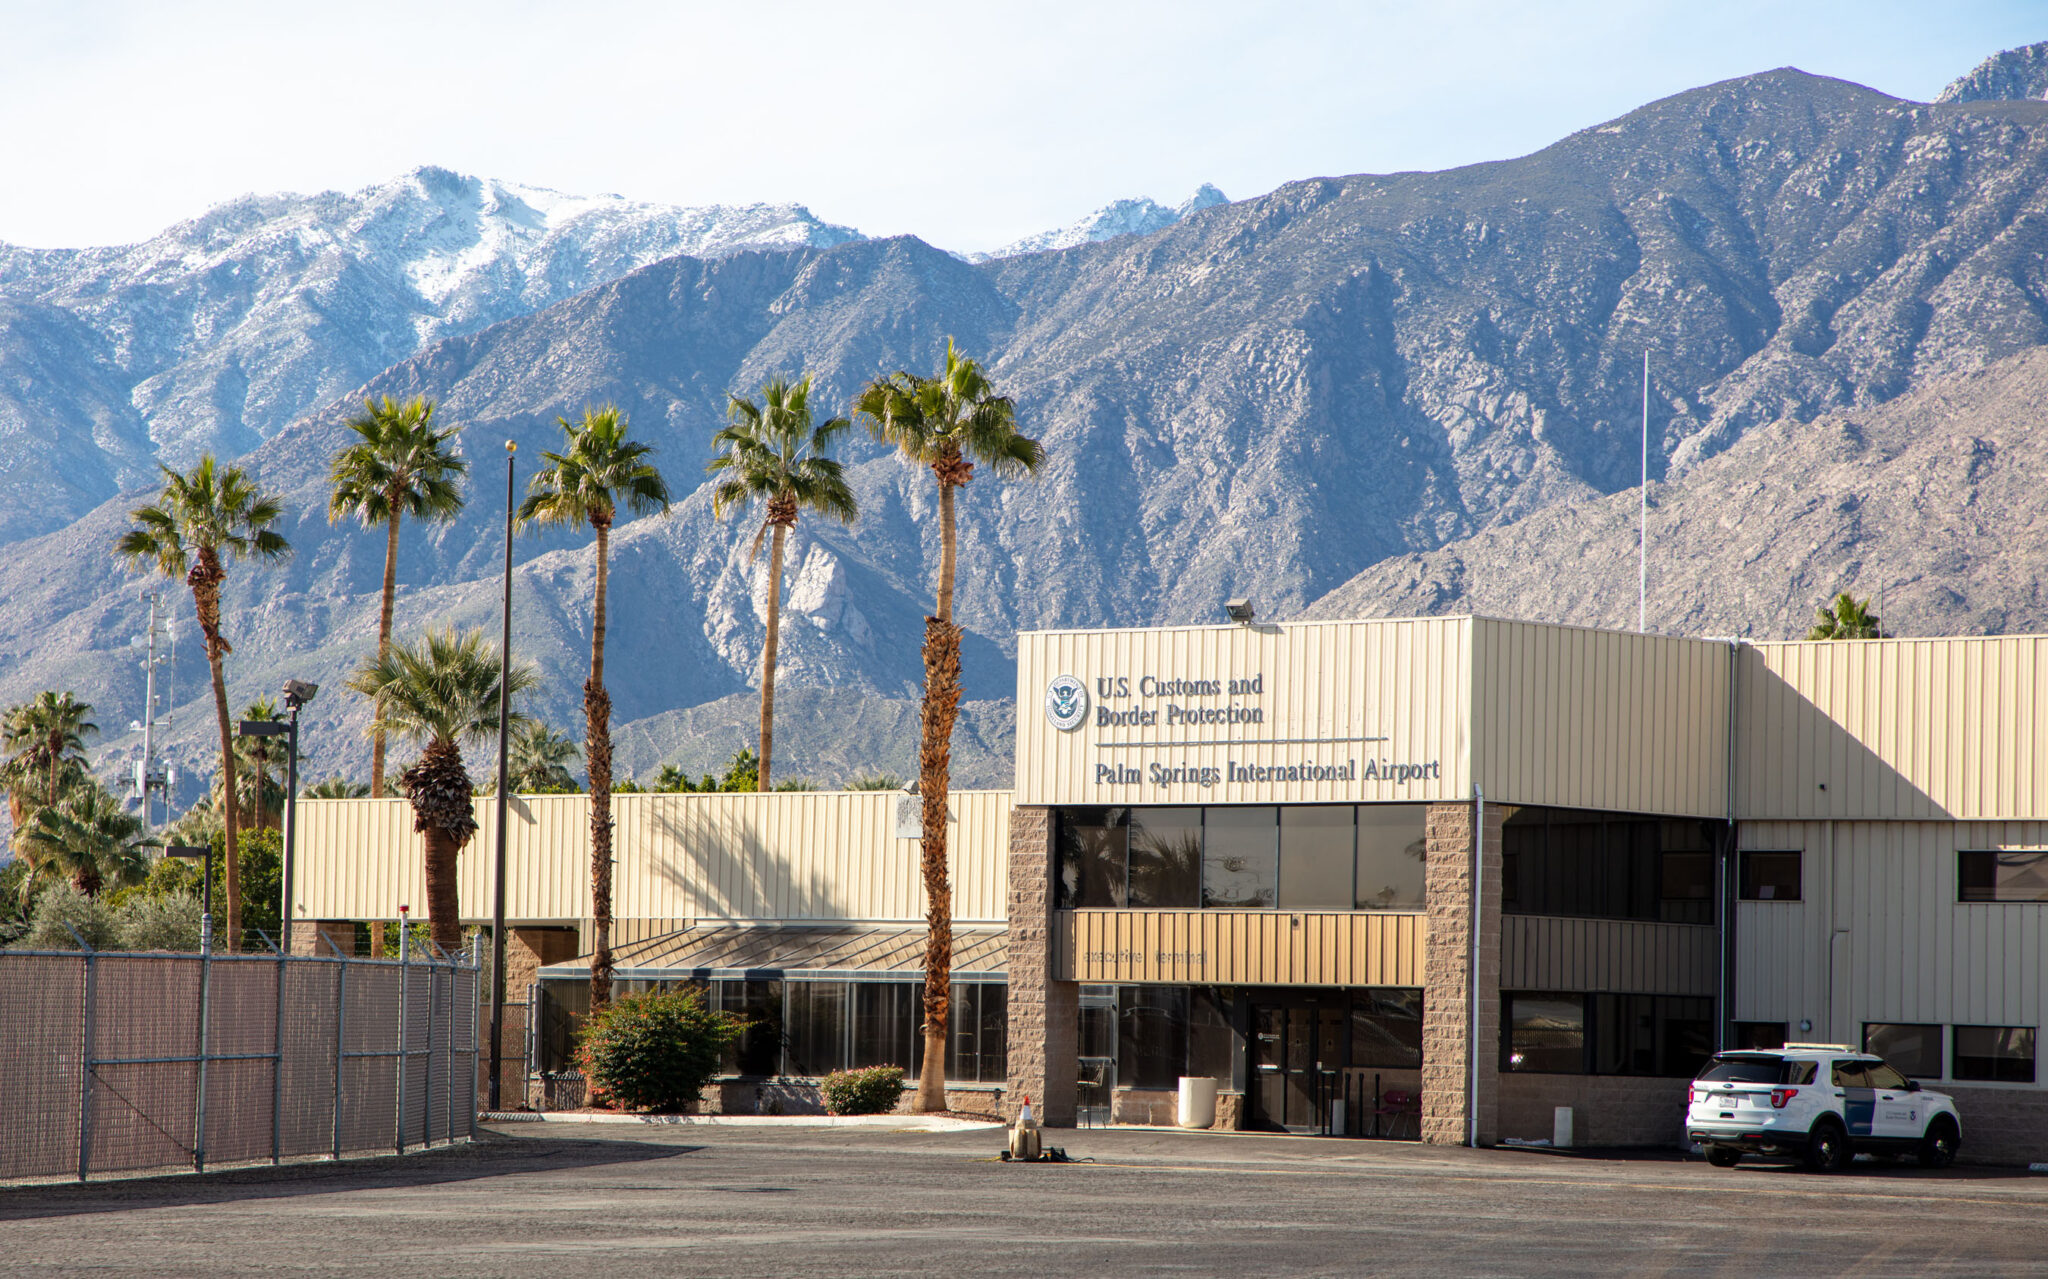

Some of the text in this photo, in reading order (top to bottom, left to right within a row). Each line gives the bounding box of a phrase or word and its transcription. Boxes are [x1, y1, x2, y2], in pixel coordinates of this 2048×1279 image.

[1096, 672, 1264, 699] U.S. Customs and
[1096, 702, 1264, 727] Border Protection
[1095, 758, 1440, 788] Palm Springs International Airport
[1083, 948, 1208, 965] executive terminal
